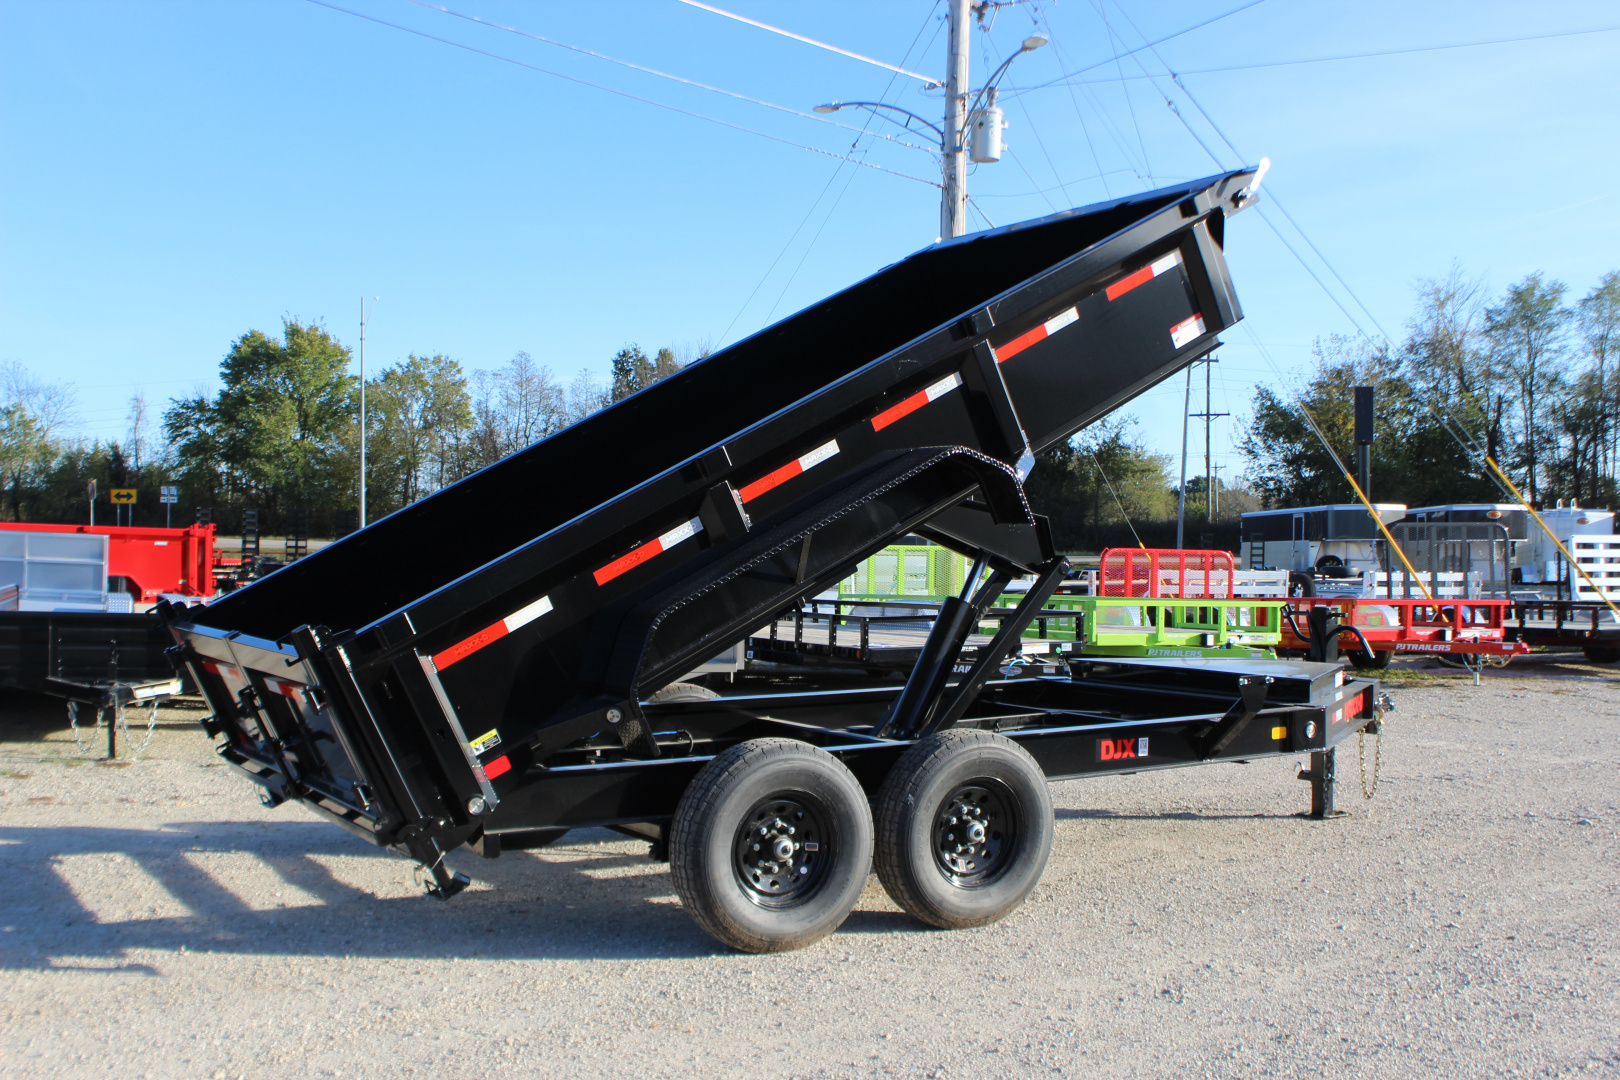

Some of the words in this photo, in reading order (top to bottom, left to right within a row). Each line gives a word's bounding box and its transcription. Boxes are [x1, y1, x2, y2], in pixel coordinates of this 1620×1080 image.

[804, 445, 833, 464] MAXX-D
[665, 522, 696, 544] MAXX-D
[613, 550, 645, 572] MAXX-D
[453, 633, 488, 656] MAXX-D
[1159, 649, 1203, 658] TRAILERS
[1406, 643, 1452, 651] TRAILERS
[1100, 738, 1136, 761] DJX
